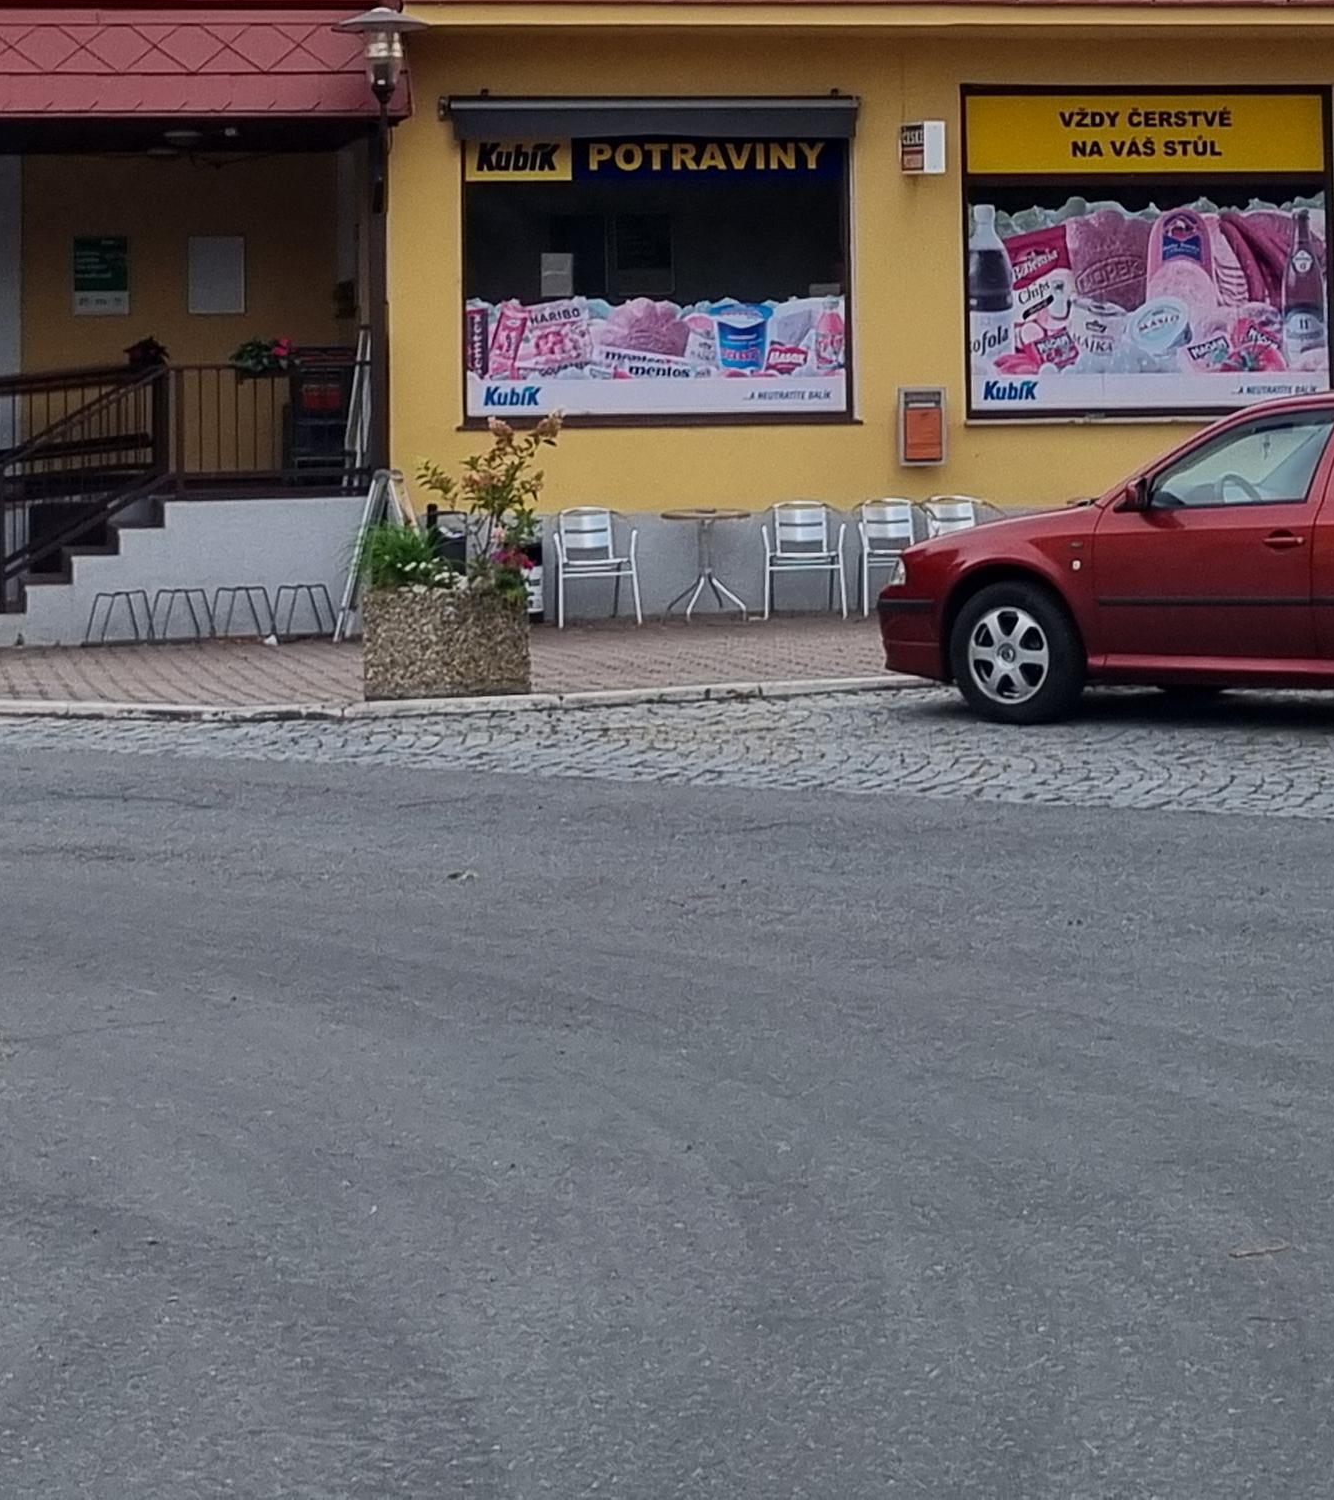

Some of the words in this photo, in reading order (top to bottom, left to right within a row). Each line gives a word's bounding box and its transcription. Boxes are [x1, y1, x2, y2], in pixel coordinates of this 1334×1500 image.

[1059, 107, 1120, 128] VŽDY
[1127, 106, 1233, 128] ČERSTVÉ
[588, 141, 827, 171] POTRAVINY
[1071, 140, 1103, 157] NA
[1110, 137, 1156, 157] VÁŠ
[1163, 135, 1223, 157] STŮL
[529, 307, 581, 325] HARIBO
[971, 325, 1009, 357] ofola
[628, 365, 690, 378] mentos
